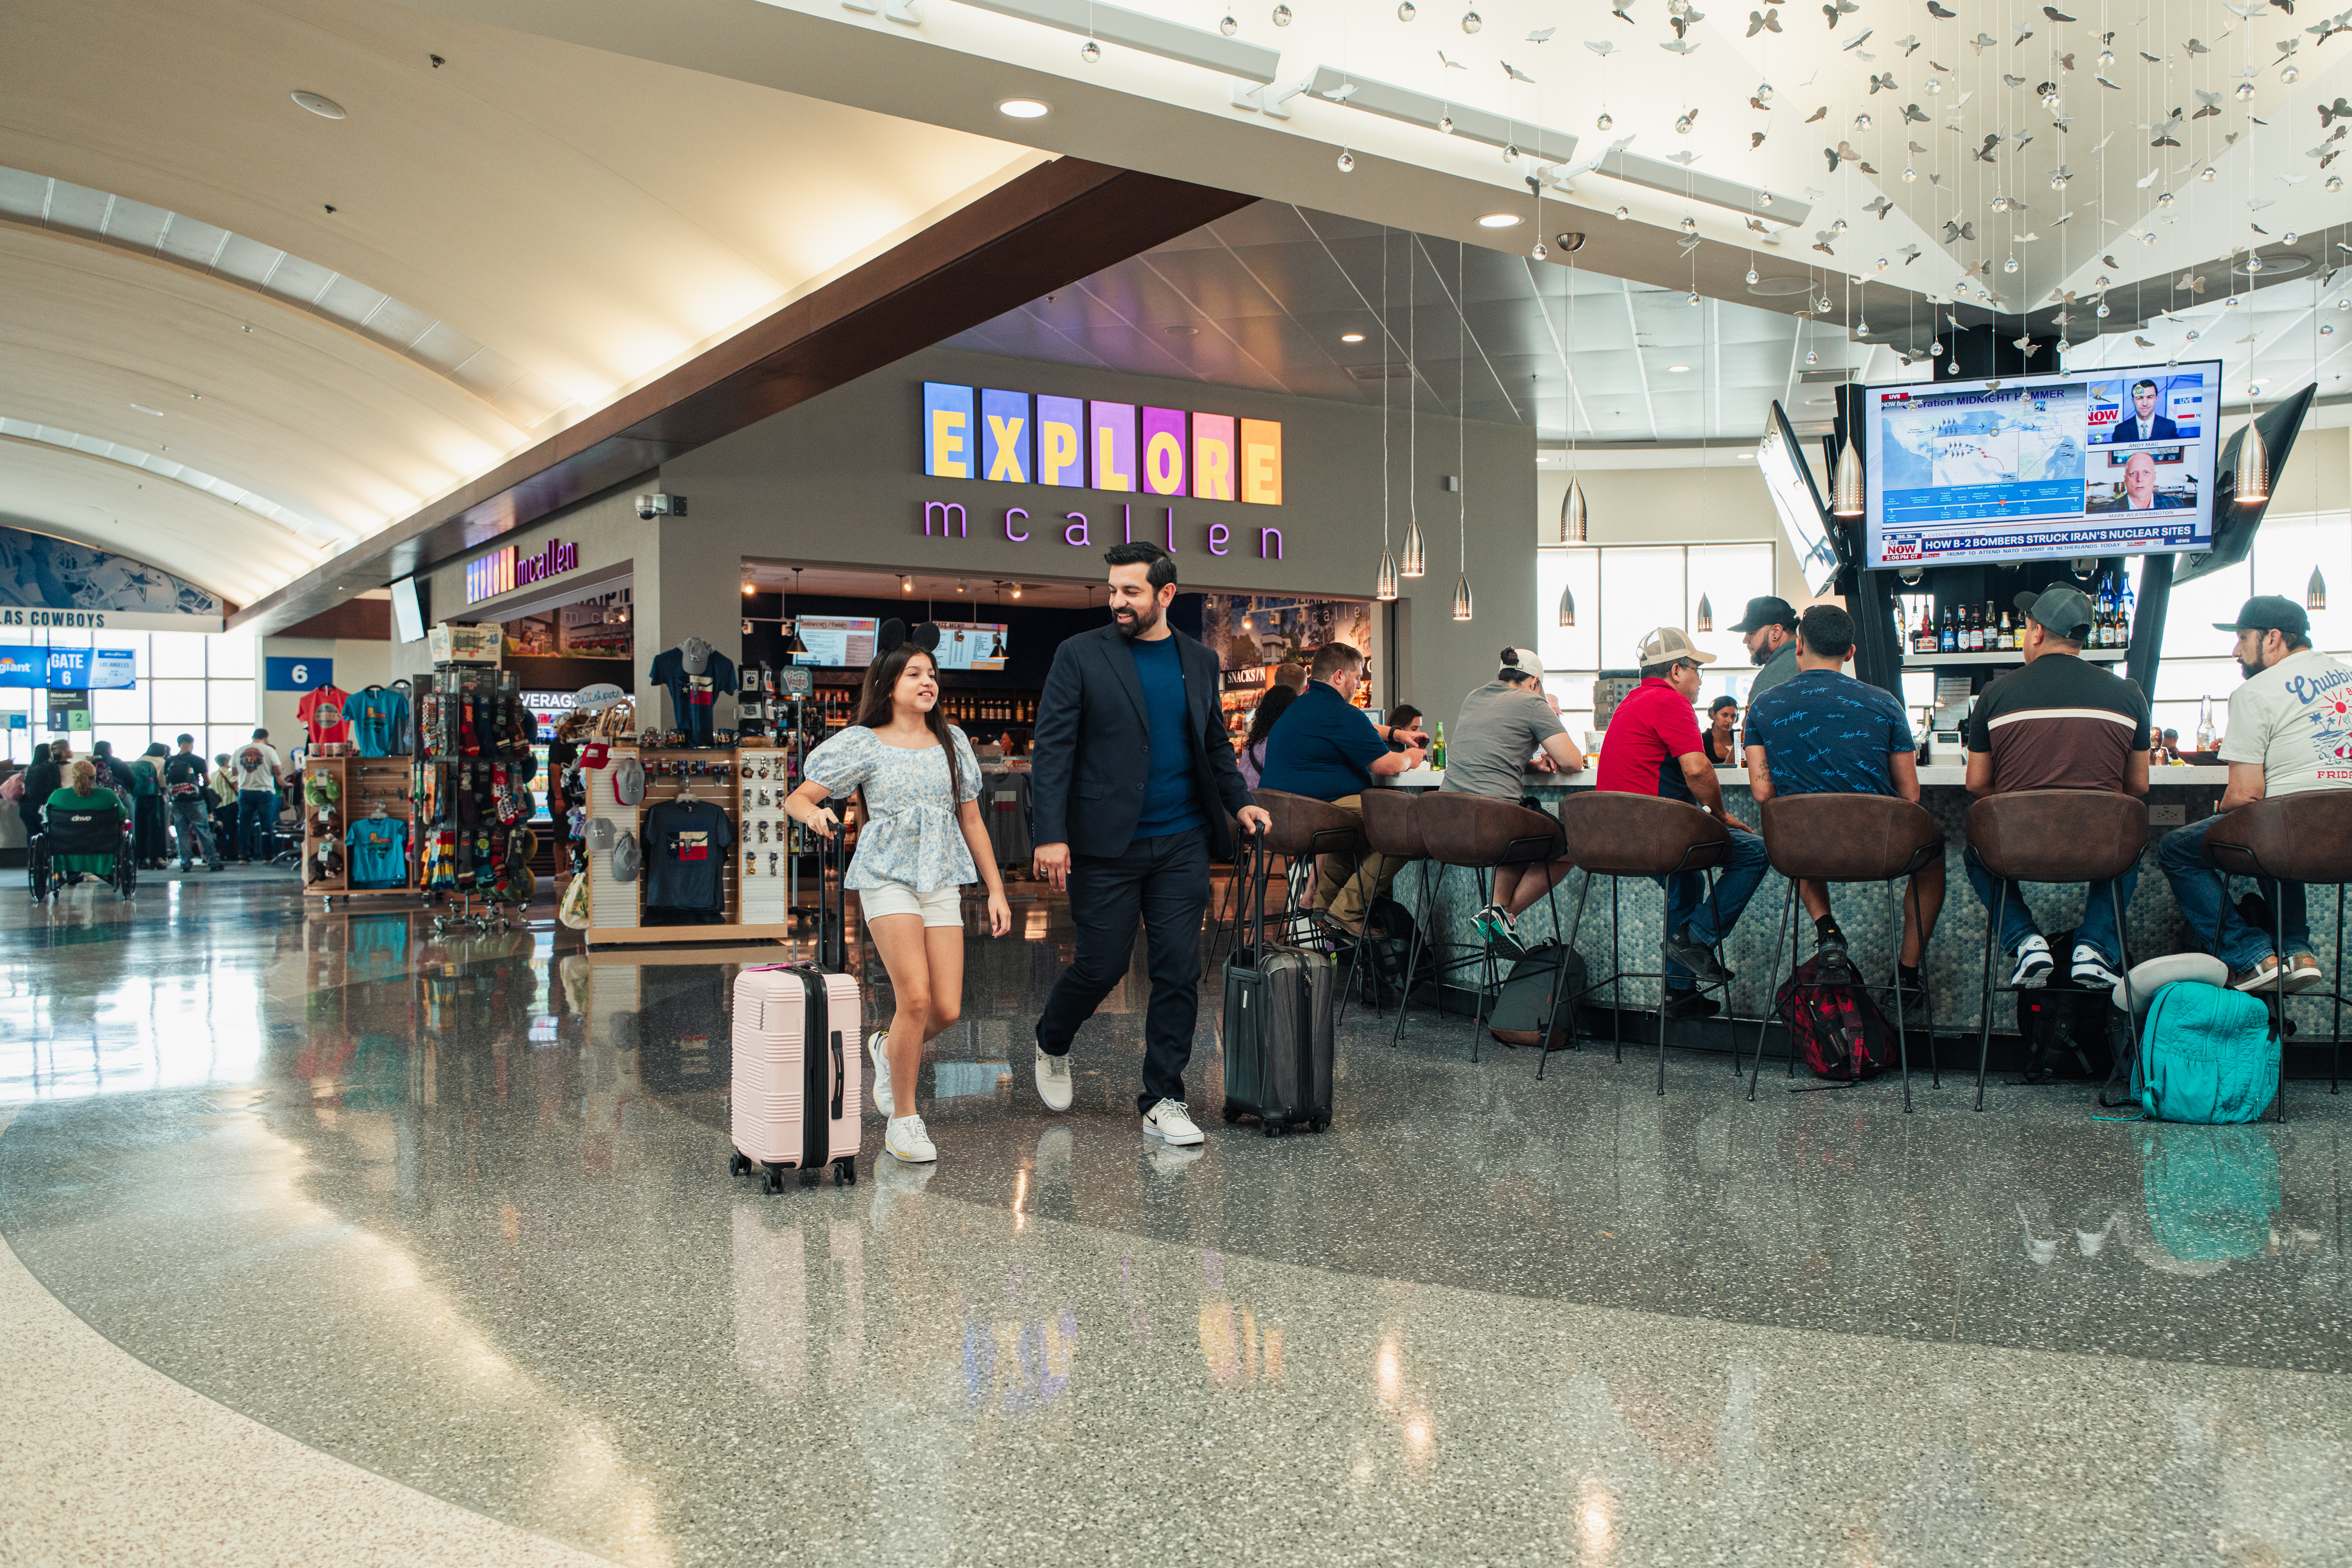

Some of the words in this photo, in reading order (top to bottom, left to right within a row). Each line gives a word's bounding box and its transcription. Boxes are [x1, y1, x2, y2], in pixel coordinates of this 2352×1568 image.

[1902, 399, 1953, 410] eration
[1956, 392, 2012, 406] MIDNIGHT
[2014, 389, 2065, 401] HMMER
[933, 409, 1276, 506] EXPLORE
[924, 501, 1282, 560] mcallen
[1925, 540, 1952, 550] HOW
[1953, 539, 1972, 548] B-2
[1973, 536, 2024, 547] BOMBERS
[2026, 533, 2069, 544] STRUCK
[2070, 530, 2107, 541] IRAN'S
[2109, 527, 2159, 540] NUCLEAR
[2161, 526, 2191, 536] SITES
[1887, 544, 1916, 554] NOW
[467, 556, 515, 605] EXPLORE
[517, 537, 575, 587] mcallen
[0, 610, 24, 626] AS
[31, 610, 105, 628] COWBOYS
[51, 653, 84, 669] GATE
[62, 671, 72, 686] 6
[292, 664, 308, 684] 6
[576, 688, 621, 705] Wishpets
[1836, 696, 1848, 704] Tommy
[55, 713, 61, 723] 1
[76, 713, 82, 722] 2
[1772, 718, 1788, 727] Tommy
[1789, 711, 1808, 721] Hilfiger
[593, 829, 605, 837] TX
